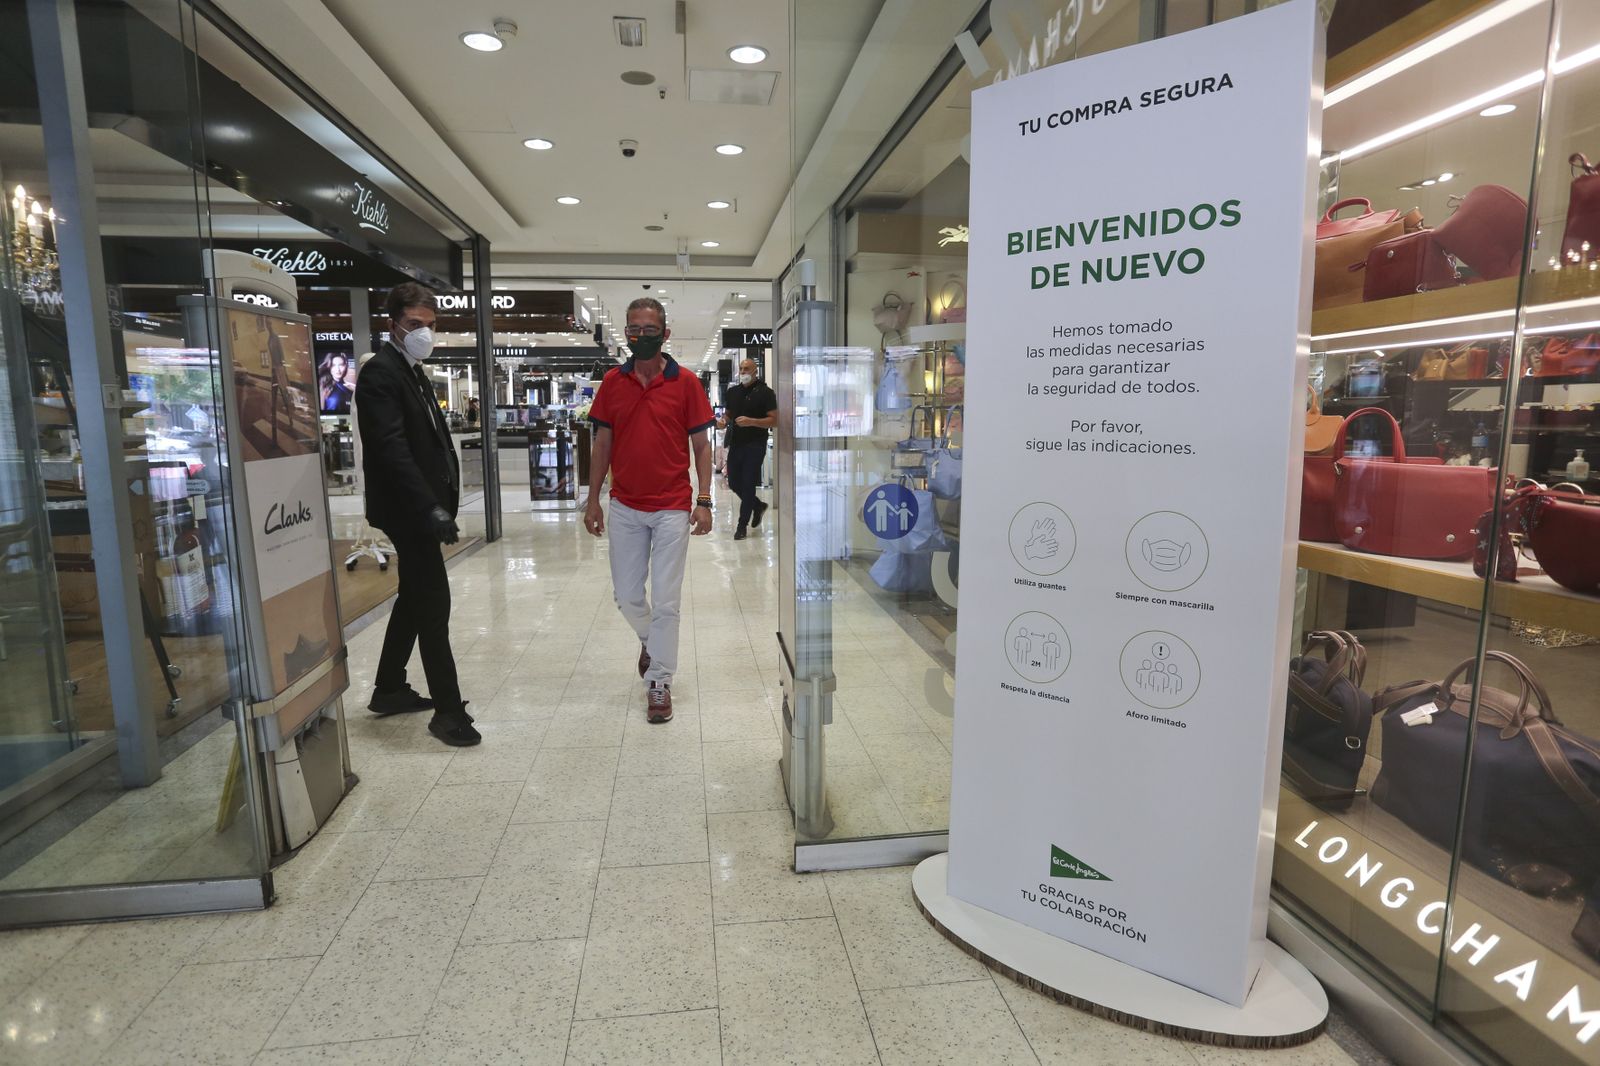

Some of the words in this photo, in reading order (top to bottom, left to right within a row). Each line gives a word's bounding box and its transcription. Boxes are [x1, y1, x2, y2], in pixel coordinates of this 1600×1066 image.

[1018, 117, 1041, 136] TU
[1047, 96, 1132, 129] COMPRA
[1140, 72, 1233, 108] SEGURA
[351, 181, 389, 230] Kiehl's
[1007, 199, 1242, 256] BIENVENIDOS
[1031, 262, 1070, 290] DE
[1081, 247, 1206, 285] NUEVO
[434, 295, 468, 309] TOM
[471, 295, 516, 309] RD
[1052, 322, 1104, 338] Hemos
[1109, 318, 1173, 335] tomado
[1026, 345, 1045, 358] las
[1049, 341, 1112, 357] medidas
[1117, 337, 1205, 355] necesarias
[1052, 362, 1084, 378] para
[1089, 359, 1170, 377] garantizar
[1027, 383, 1039, 395] la
[1043, 381, 1116, 397] seguridad
[1121, 380, 1142, 394] de
[1147, 379, 1200, 394] todos.
[1071, 419, 1096, 433] Por
[1101, 419, 1143, 435] favor,
[1025, 438, 1063, 452] sigue
[1067, 438, 1086, 452] las
[1091, 439, 1196, 455] indicaciones.
[264, 500, 311, 535] Clarks
[1014, 578, 1037, 588] Utiliza
[1038, 582, 1067, 592] guantes
[1115, 591, 1149, 604] Siempre
[1151, 597, 1167, 606] con
[1169, 599, 1215, 612] mascarilla
[1031, 660, 1041, 668] 2M
[1000, 682, 1028, 695] Respeta
[1029, 688, 1036, 696] la
[1037, 690, 1070, 704] distancia
[1126, 710, 1149, 722] Aforo
[1151, 714, 1187, 729] limitado
[1039, 883, 1095, 911] GRACIAS
[1099, 904, 1127, 922] POR
[1021, 889, 1036, 903] TU
[1040, 897, 1147, 944] COLABORACIÓN
